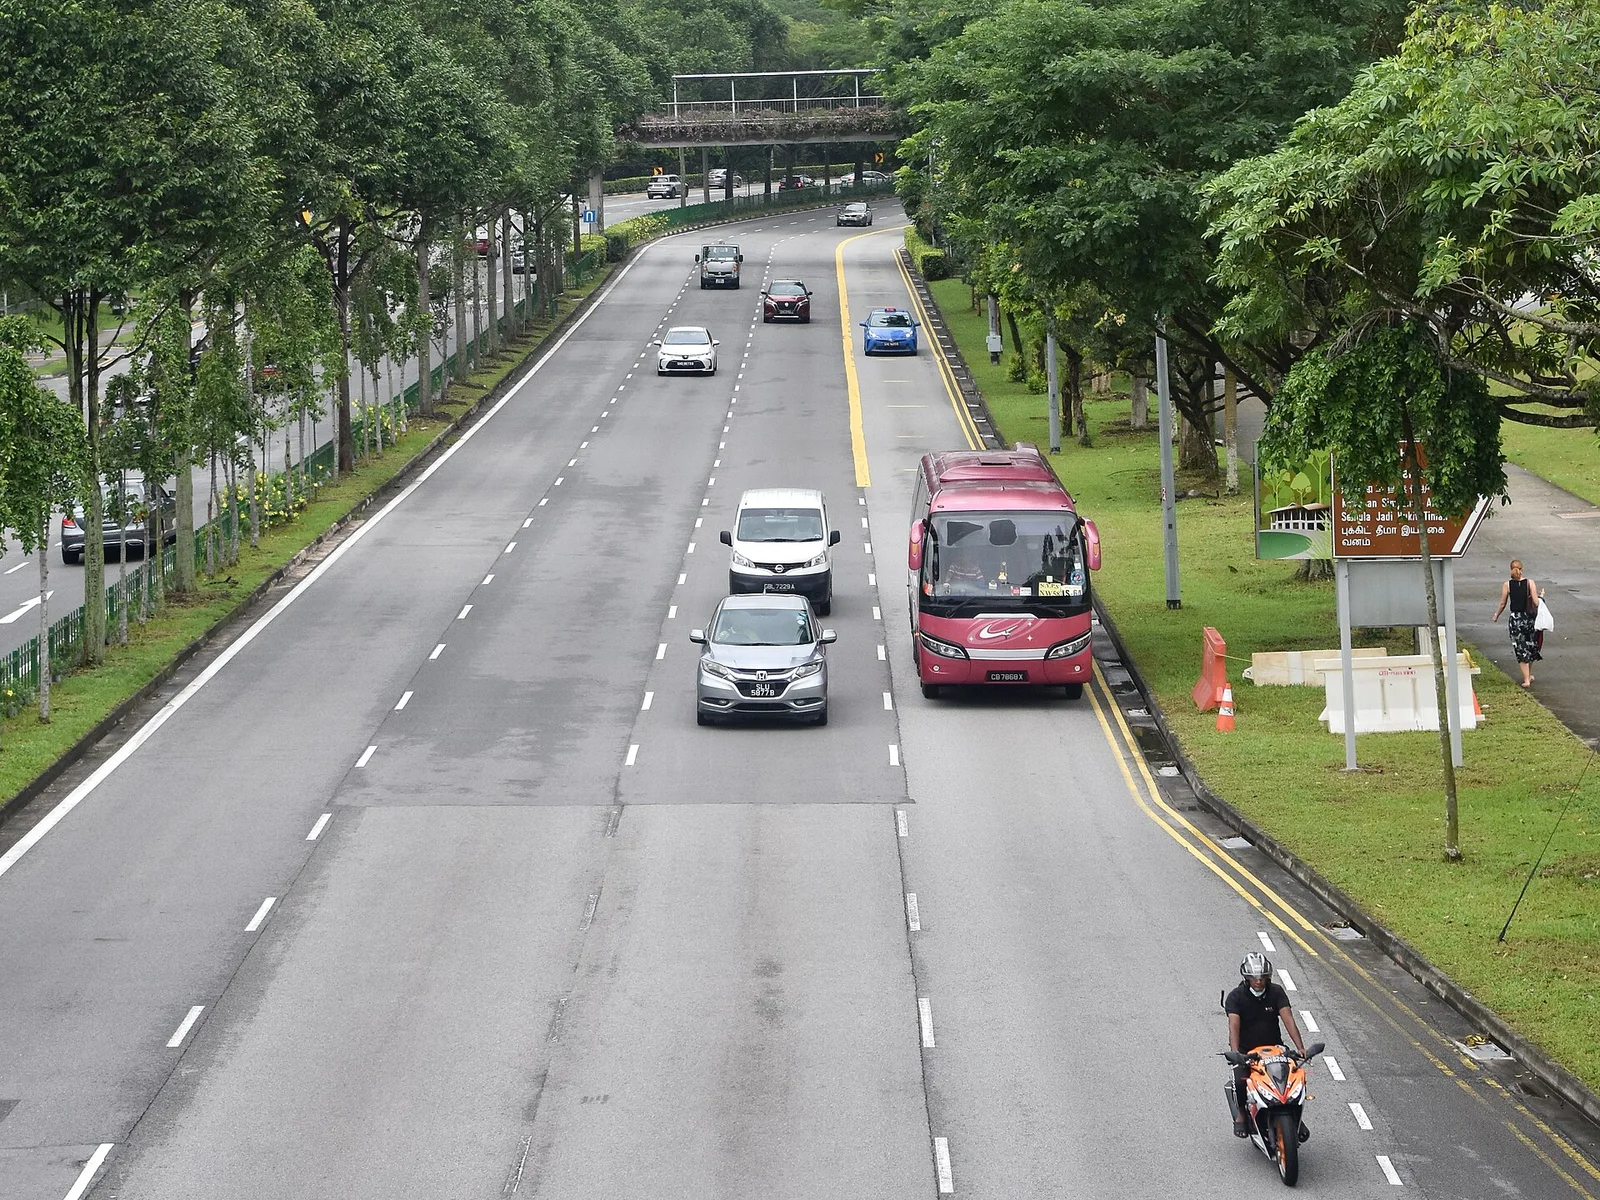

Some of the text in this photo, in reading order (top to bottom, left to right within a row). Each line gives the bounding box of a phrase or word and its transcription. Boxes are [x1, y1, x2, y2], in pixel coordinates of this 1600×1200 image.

[1375, 511, 1393, 521] Jadi
[1375, 525, 1397, 537] தீமா
[1341, 538, 1371, 546] வனம்
